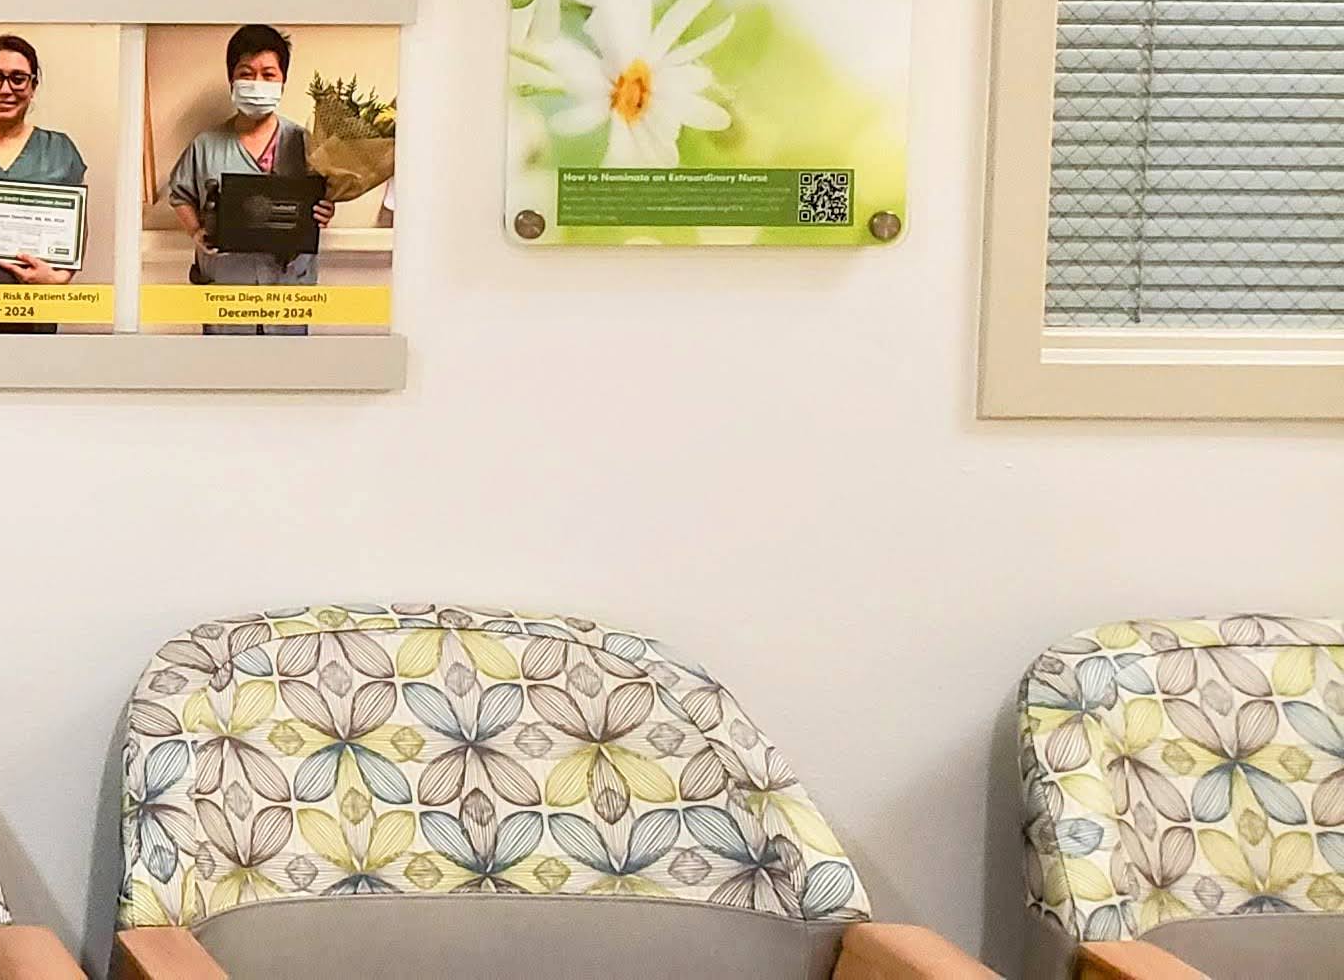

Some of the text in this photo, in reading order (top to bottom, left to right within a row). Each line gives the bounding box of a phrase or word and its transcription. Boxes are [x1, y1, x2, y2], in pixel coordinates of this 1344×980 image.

[4, 306, 34, 316] 2024
[218, 307, 312, 318] December 2024
